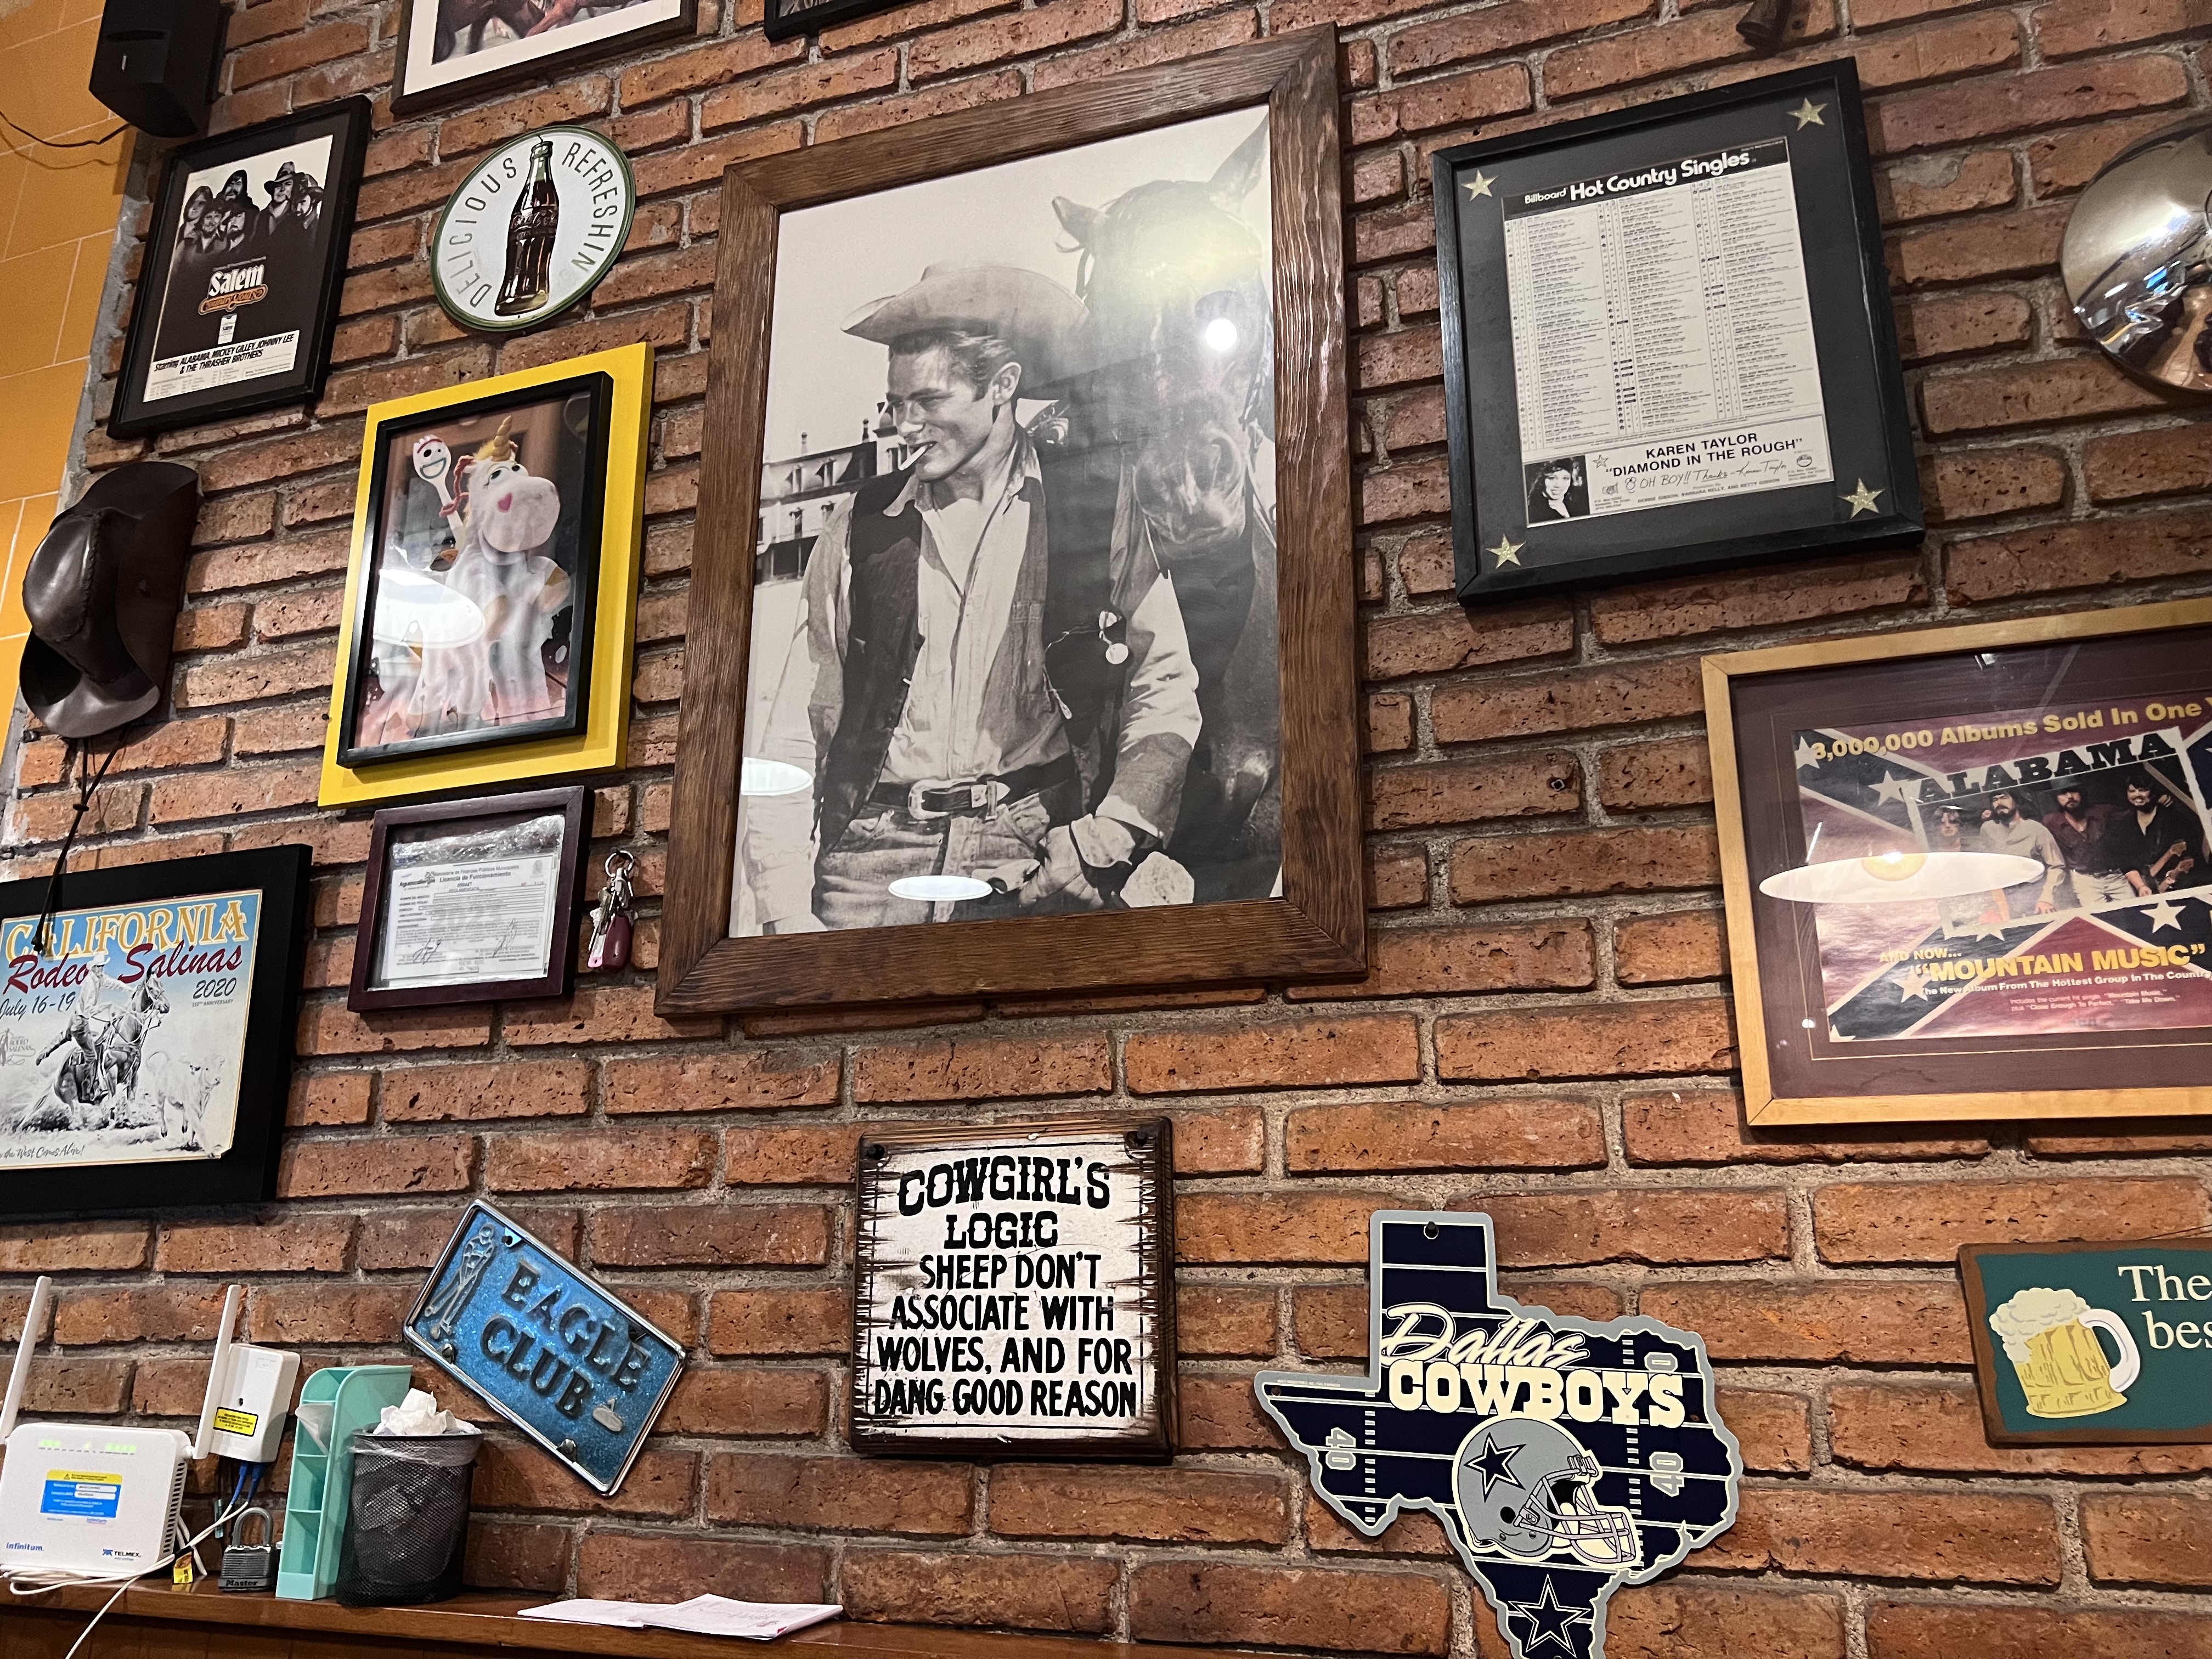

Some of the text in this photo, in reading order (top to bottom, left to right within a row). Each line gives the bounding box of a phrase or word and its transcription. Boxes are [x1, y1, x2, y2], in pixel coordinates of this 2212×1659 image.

[1524, 151, 1751, 205] Billboard Hot Country Singles
[562, 142, 618, 272] REFRESHIN
[447, 157, 517, 307] DELICIOUS
[208, 264, 264, 296] Salem
[154, 359, 179, 371] Starring
[211, 346, 235, 358] MICKEY
[256, 336, 283, 349] JOHNNY
[282, 334, 295, 343] LEE
[179, 366, 185, 374] &
[185, 363, 199, 373] THE
[199, 356, 232, 370] THRASHER
[231, 348, 264, 364] BROTHERS
[1605, 438, 1803, 477] "DIAMOND IN THE ROUGH"
[1646, 433, 1758, 459] KAREN TAYLOR
[1639, 475, 1656, 489] OH
[1692, 469, 1728, 482] Thanks
[1810, 703, 2202, 762] 3,000,000 Albums Sold In One
[1918, 732, 2177, 803] ALABAMA
[469, 871, 511, 879] Funcionamiento
[5, 900, 249, 962] CALIFORNIA
[3, 940, 243, 995] Rodeo Salinas
[1879, 948, 1962, 963] AND NOW...
[1915, 943, 2206, 982] "MOUNTAIN MUSIC"
[193, 977, 237, 999] 2020
[1939, 986, 1962, 995] New
[1962, 984, 1999, 994] Album
[1999, 981, 2028, 991] From
[2029, 980, 2049, 989] The
[2051, 977, 2093, 987] Hottest
[2095, 975, 2129, 985] Group
[2130, 974, 2142, 982] In
[2142, 972, 2164, 981] The
[0, 991, 76, 1022] July 16-19
[897, 1155, 1111, 1217] COWGIRL'S
[944, 1210, 1059, 1250] LOGIC
[919, 1251, 1102, 1290] SHEEP DON'T
[2118, 1265, 2212, 1302] The
[501, 1259, 652, 1388] EAGLE
[889, 1294, 1114, 1331] ASSOCIATE WITH
[1381, 1302, 1590, 1368] Dallas
[481, 1316, 595, 1419] CLUB
[877, 1336, 1133, 1375] WOLVES, AND FOR
[874, 1378, 1137, 1418] DANG GOOD REASON
[1389, 1359, 1685, 1429] COWBOYS
[1324, 1426, 1357, 1471] 40
[1649, 1451, 1685, 1497] 40
[5, 1542, 43, 1552] infinitum
[226, 1578, 259, 1587] Master
